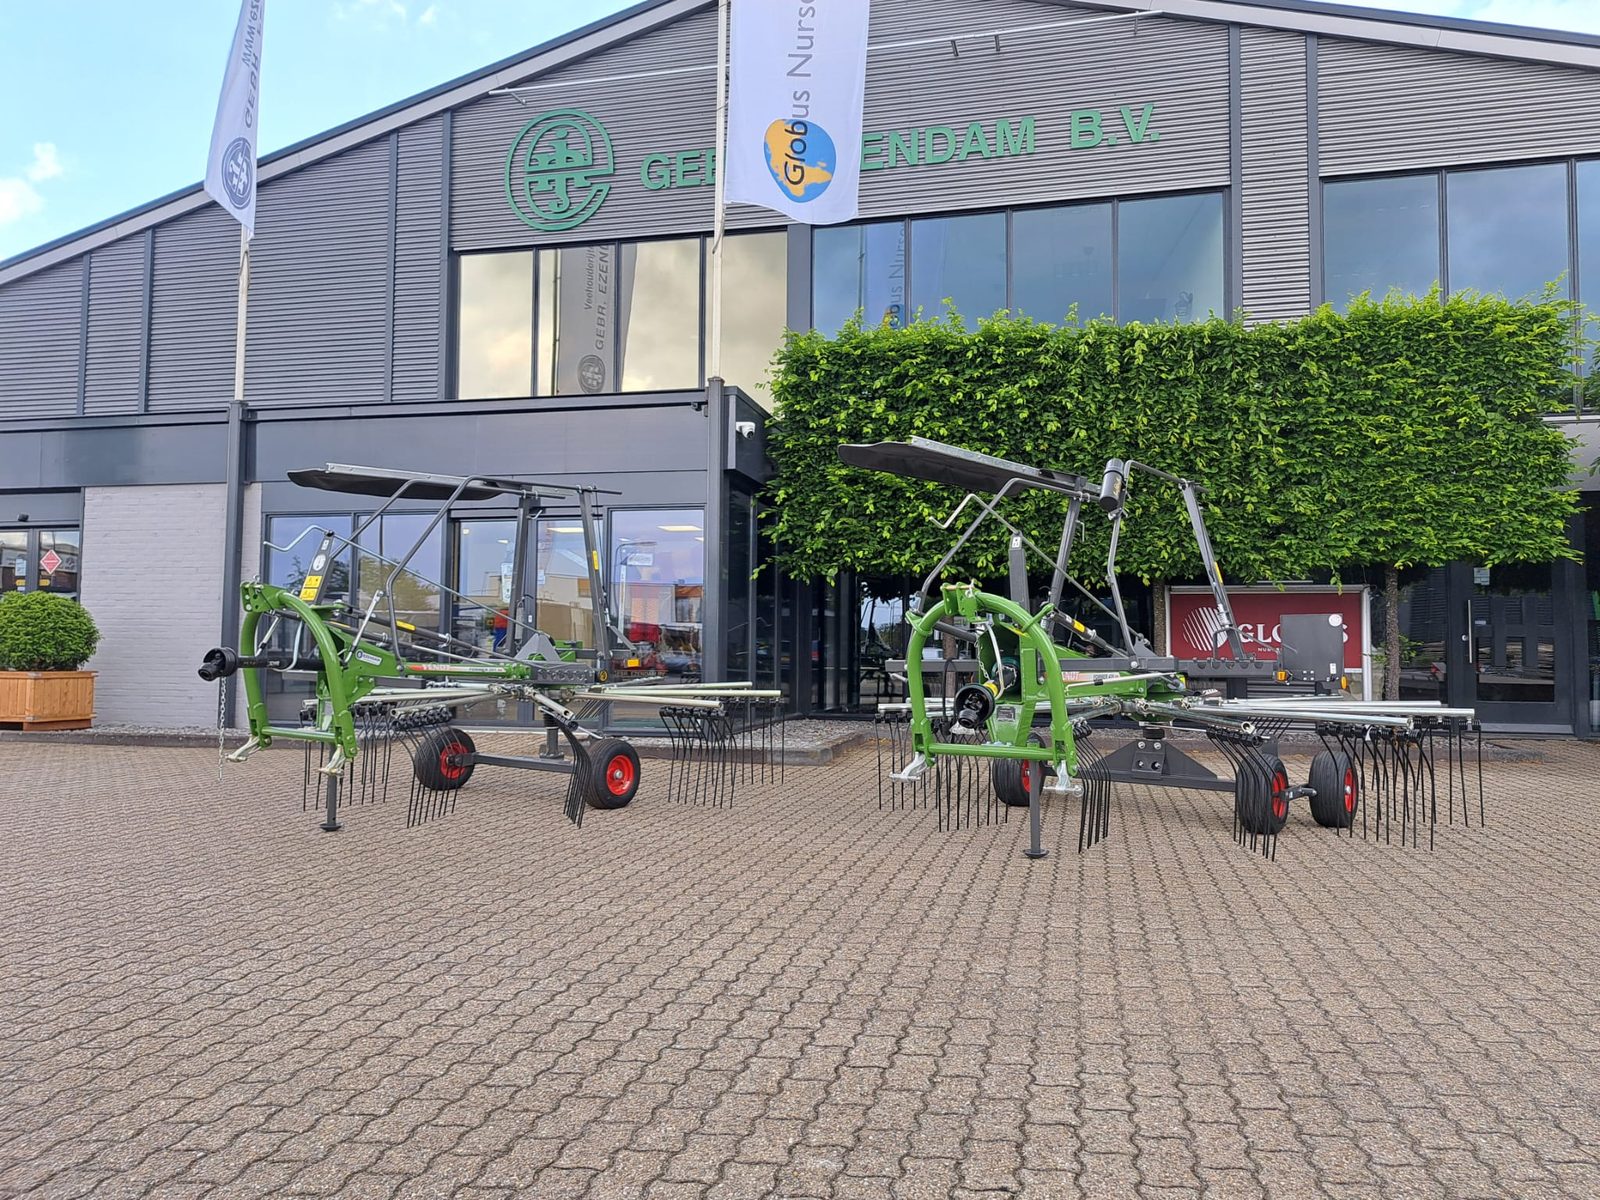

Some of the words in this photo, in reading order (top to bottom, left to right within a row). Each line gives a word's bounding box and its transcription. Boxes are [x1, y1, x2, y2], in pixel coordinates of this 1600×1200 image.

[786, 0, 816, 77] Nurs
[784, 90, 810, 186] Globus
[1070, 103, 1161, 150] B.V.
